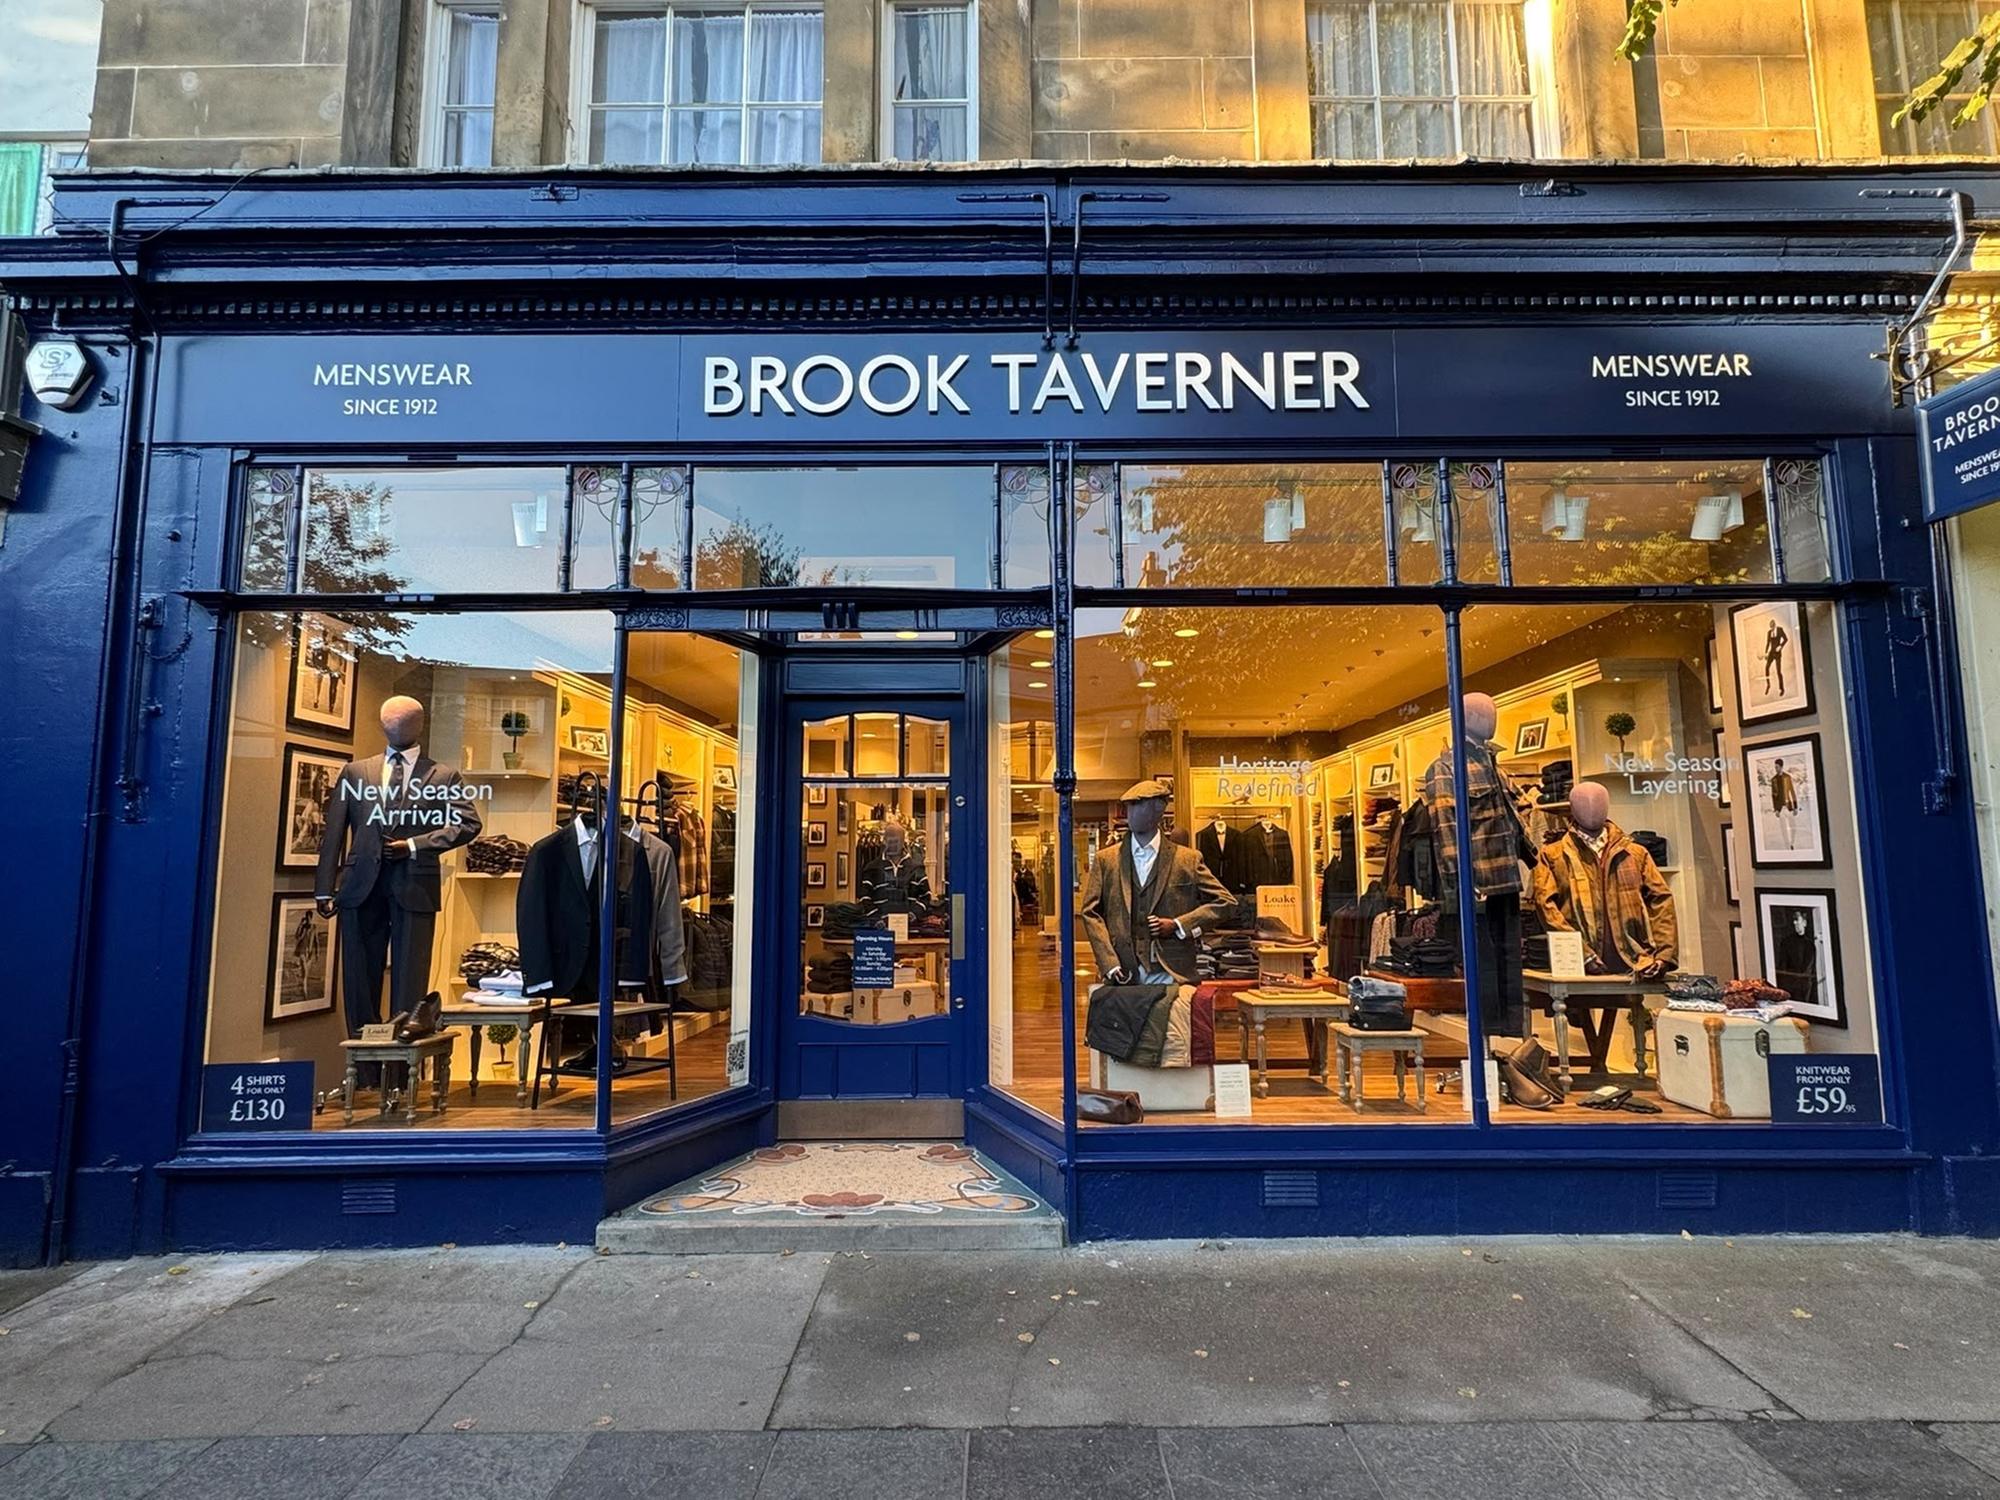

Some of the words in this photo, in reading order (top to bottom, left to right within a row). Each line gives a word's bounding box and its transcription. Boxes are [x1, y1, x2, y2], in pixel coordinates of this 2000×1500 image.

[313, 363, 473, 386] MENSWEAR
[1592, 353, 1753, 378] MENSWEAR
[703, 354, 971, 416] BROOK
[991, 351, 1370, 413] TAVERNER
[343, 398, 400, 415] SINCE
[404, 398, 438, 415] 1912
[1625, 389, 1683, 407] SINCE
[1685, 389, 1721, 406] 1912
[1960, 465, 1990, 484] SINCE
[1219, 755, 1314, 780] Heritage
[1604, 752, 1656, 772] New
[1663, 751, 1740, 772] Season
[340, 778, 400, 801] New
[408, 778, 493, 800] Season
[1217, 776, 1319, 802] Redefined
[1629, 774, 1720, 800] Layering
[366, 803, 463, 826] Arrivals
[1264, 894, 1296, 904] Loake
[1795, 1066, 1851, 1075] KNITWEAR
[1796, 1076, 1823, 1084] FROM
[1825, 1076, 1851, 1084] ONLY
[230, 1075, 245, 1095] 4
[246, 1074, 286, 1086] SHIRTS
[246, 1087, 262, 1095] FOR
[263, 1086, 285, 1094] ONLY
[229, 1098, 285, 1121] £130
